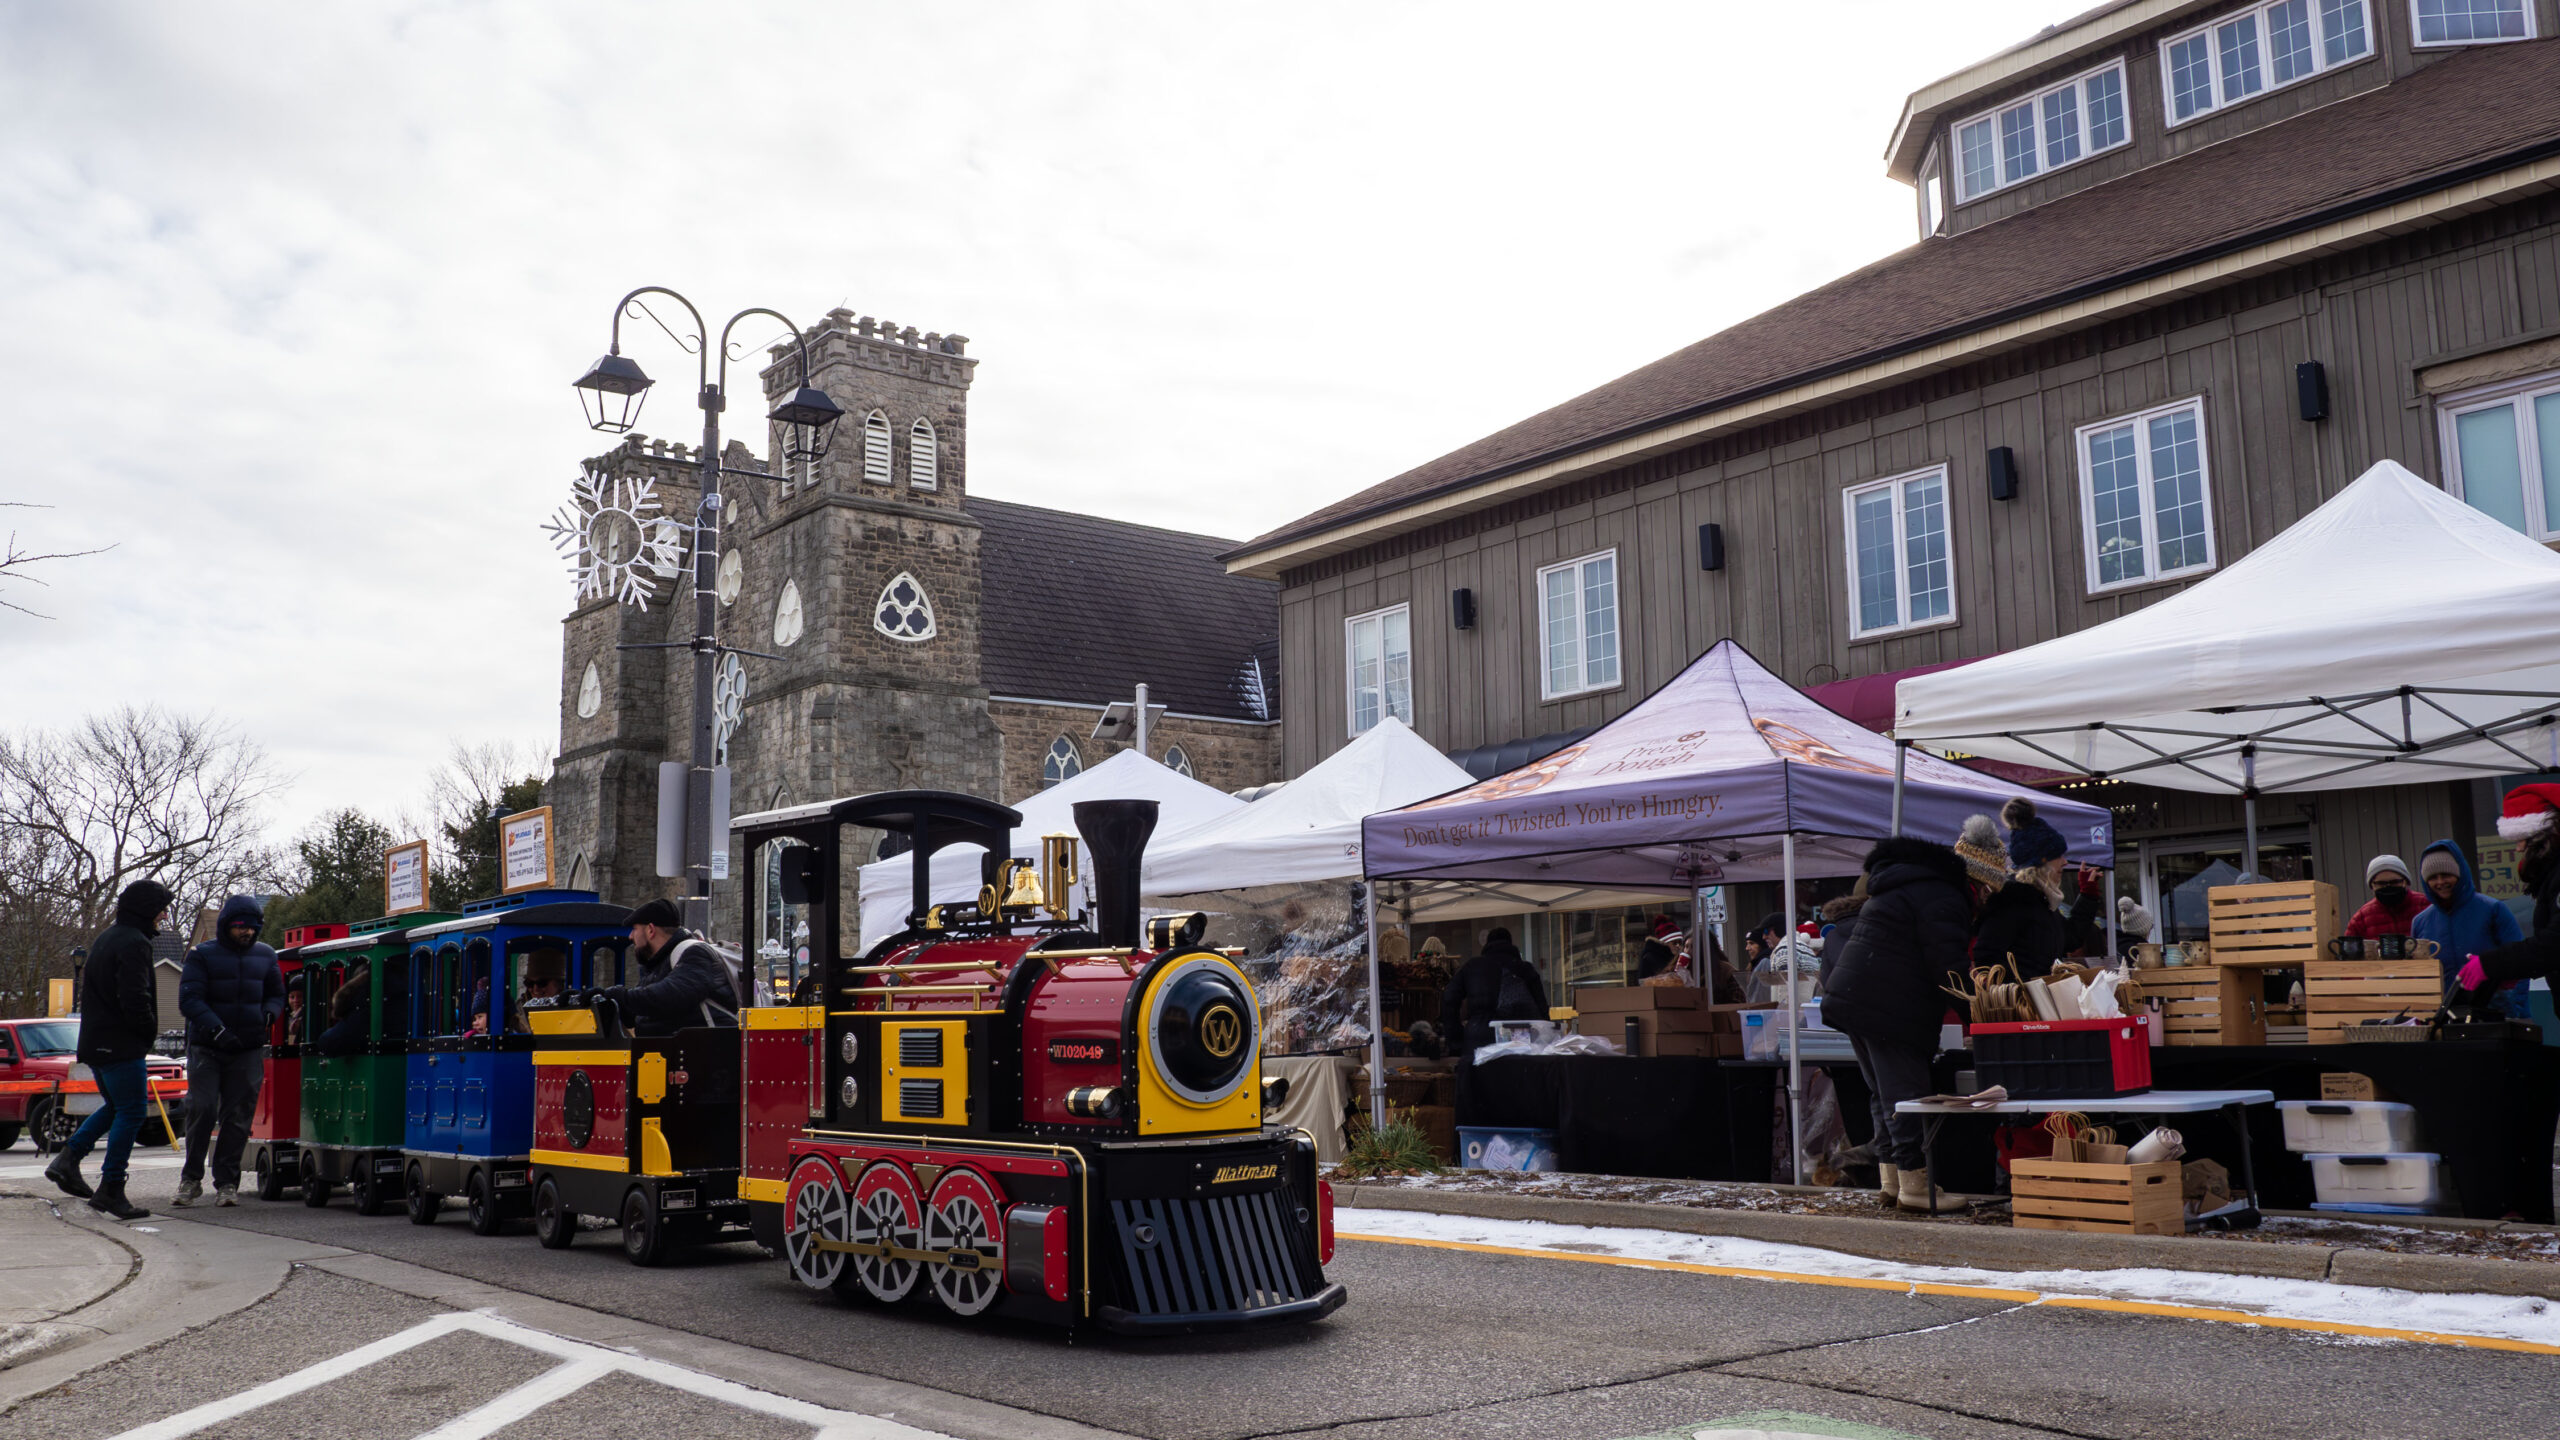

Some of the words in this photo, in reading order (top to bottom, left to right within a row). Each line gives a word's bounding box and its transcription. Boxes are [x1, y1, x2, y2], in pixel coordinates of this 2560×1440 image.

[1623, 739, 1708, 759] Pretzel
[1593, 751, 1695, 776] Dough
[1403, 822, 1448, 848] Don't
[1450, 822, 1474, 847] get
[1478, 817, 1490, 837] it
[1495, 806, 1570, 834] Twisted.
[1575, 799, 1636, 825] You're
[1641, 794, 1723, 820] Hungry.
[1206, 1012, 1237, 1053] W
[1052, 1044, 1102, 1059] W1020-48
[1211, 1164, 1278, 1184] Wattman
